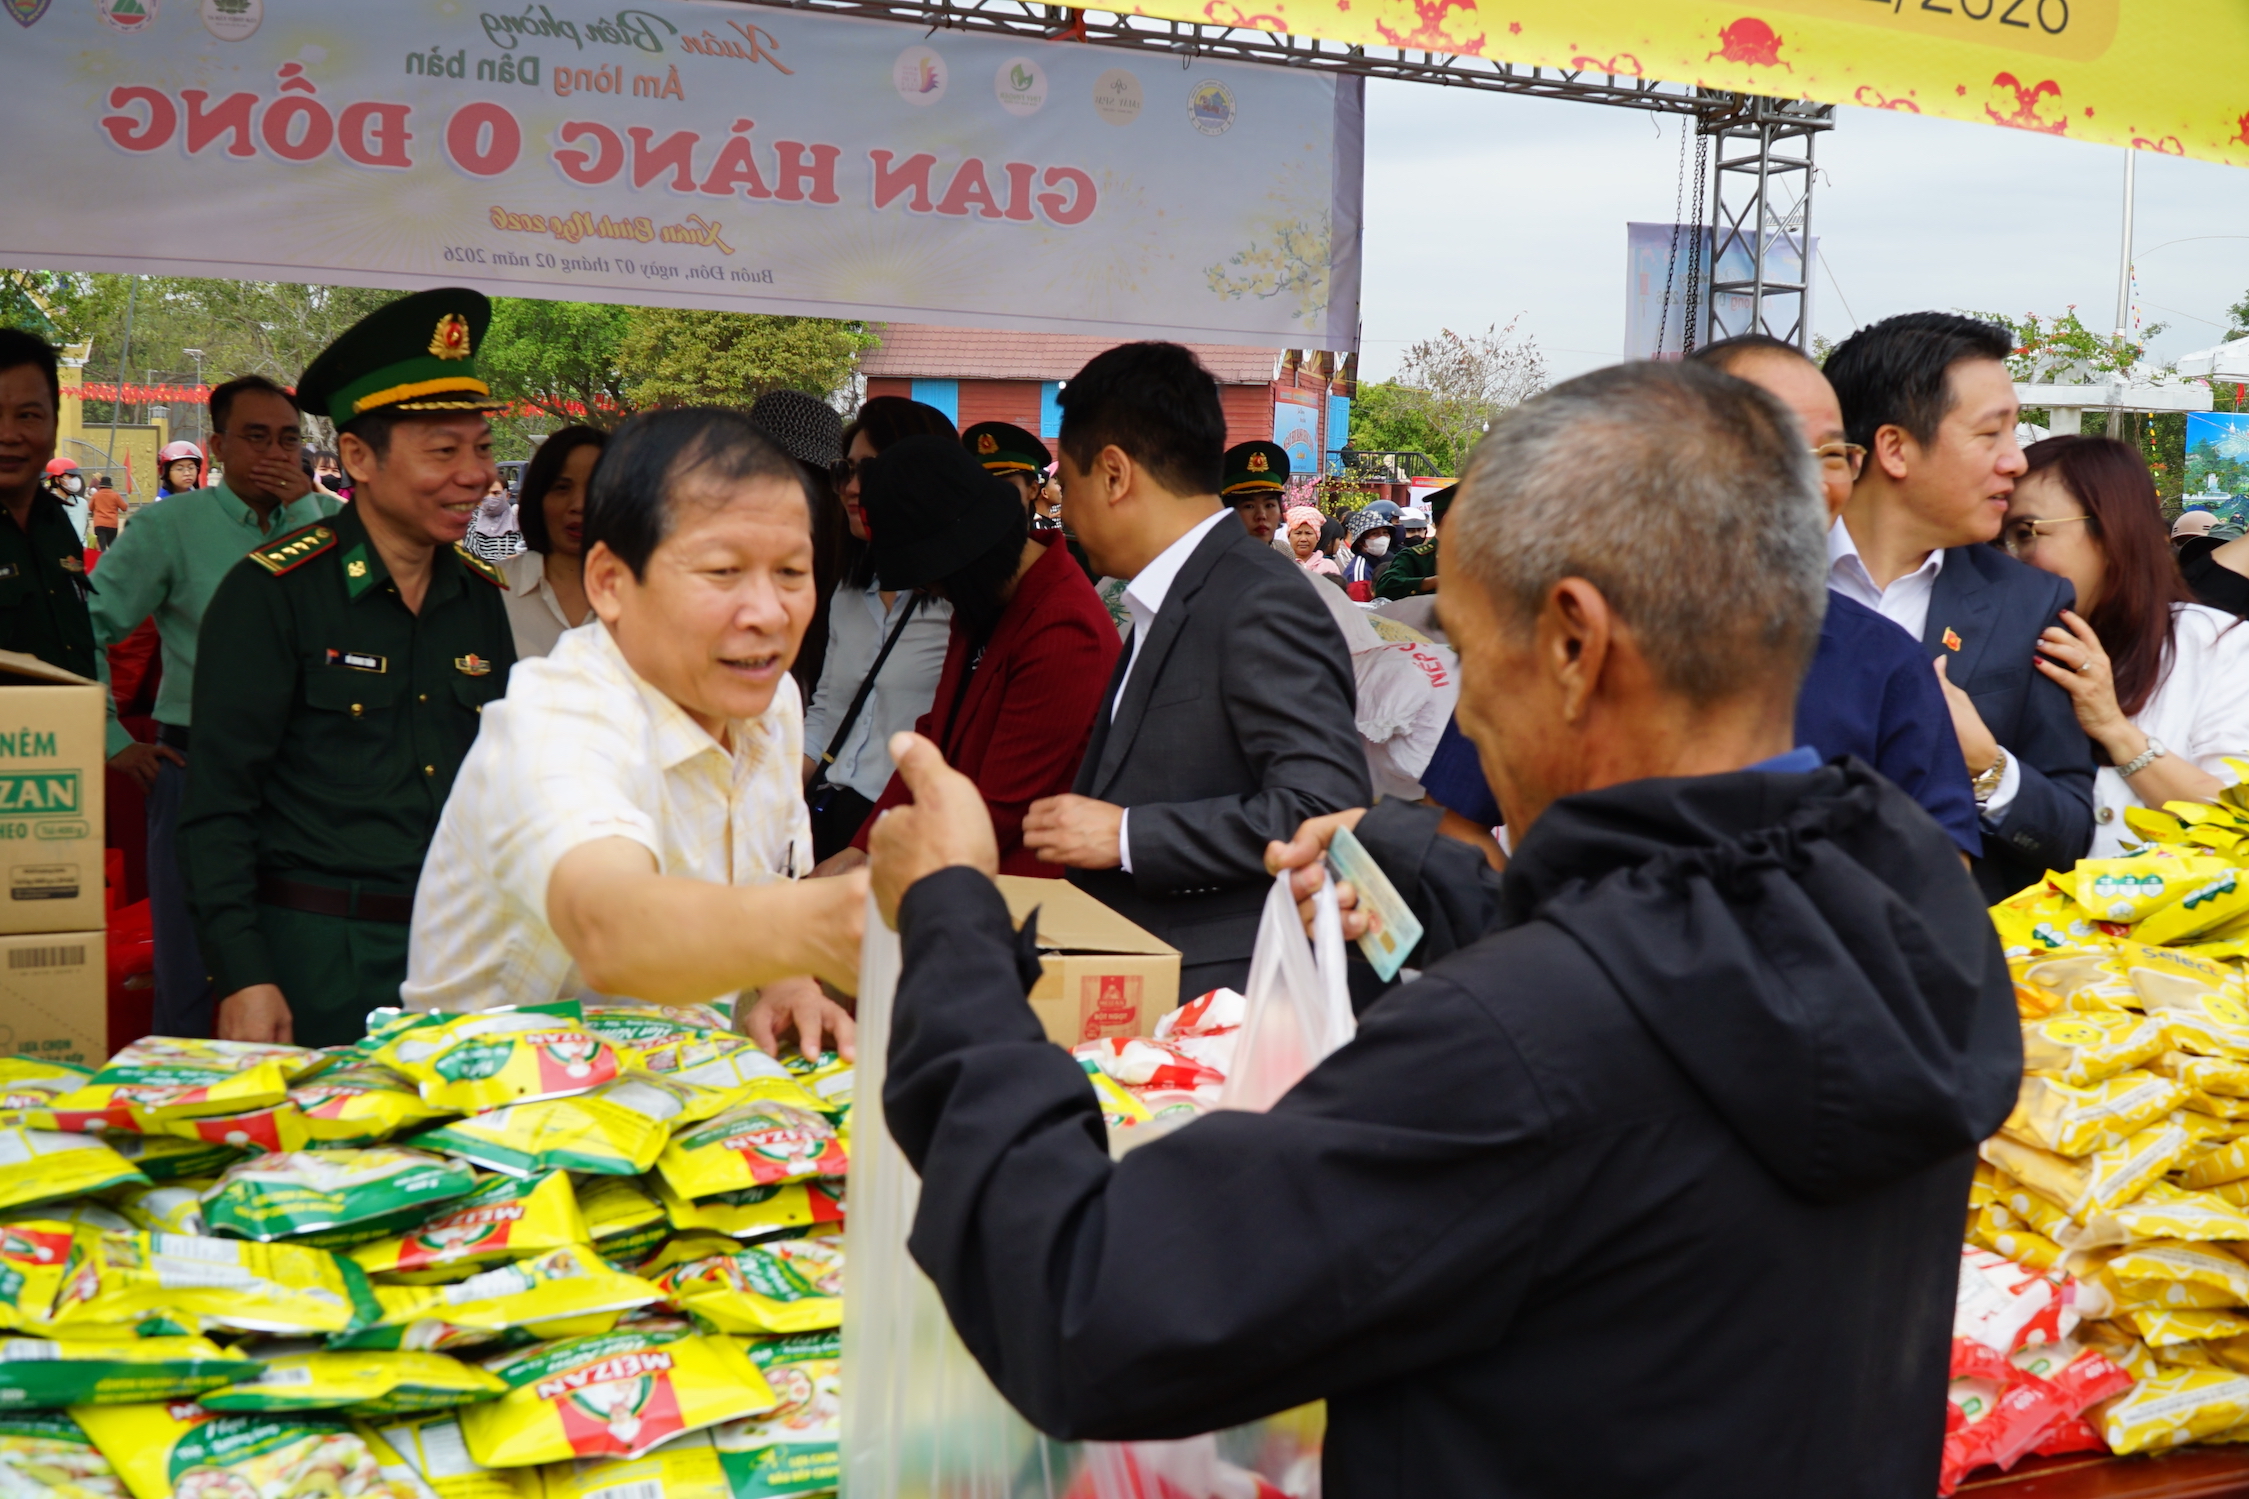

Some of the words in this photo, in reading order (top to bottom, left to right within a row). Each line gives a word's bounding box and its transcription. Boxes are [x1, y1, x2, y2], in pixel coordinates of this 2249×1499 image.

[0, 726, 57, 757] NÊM
[2142, 947, 2220, 977] Select
[537, 1352, 673, 1400] MEIZAN
